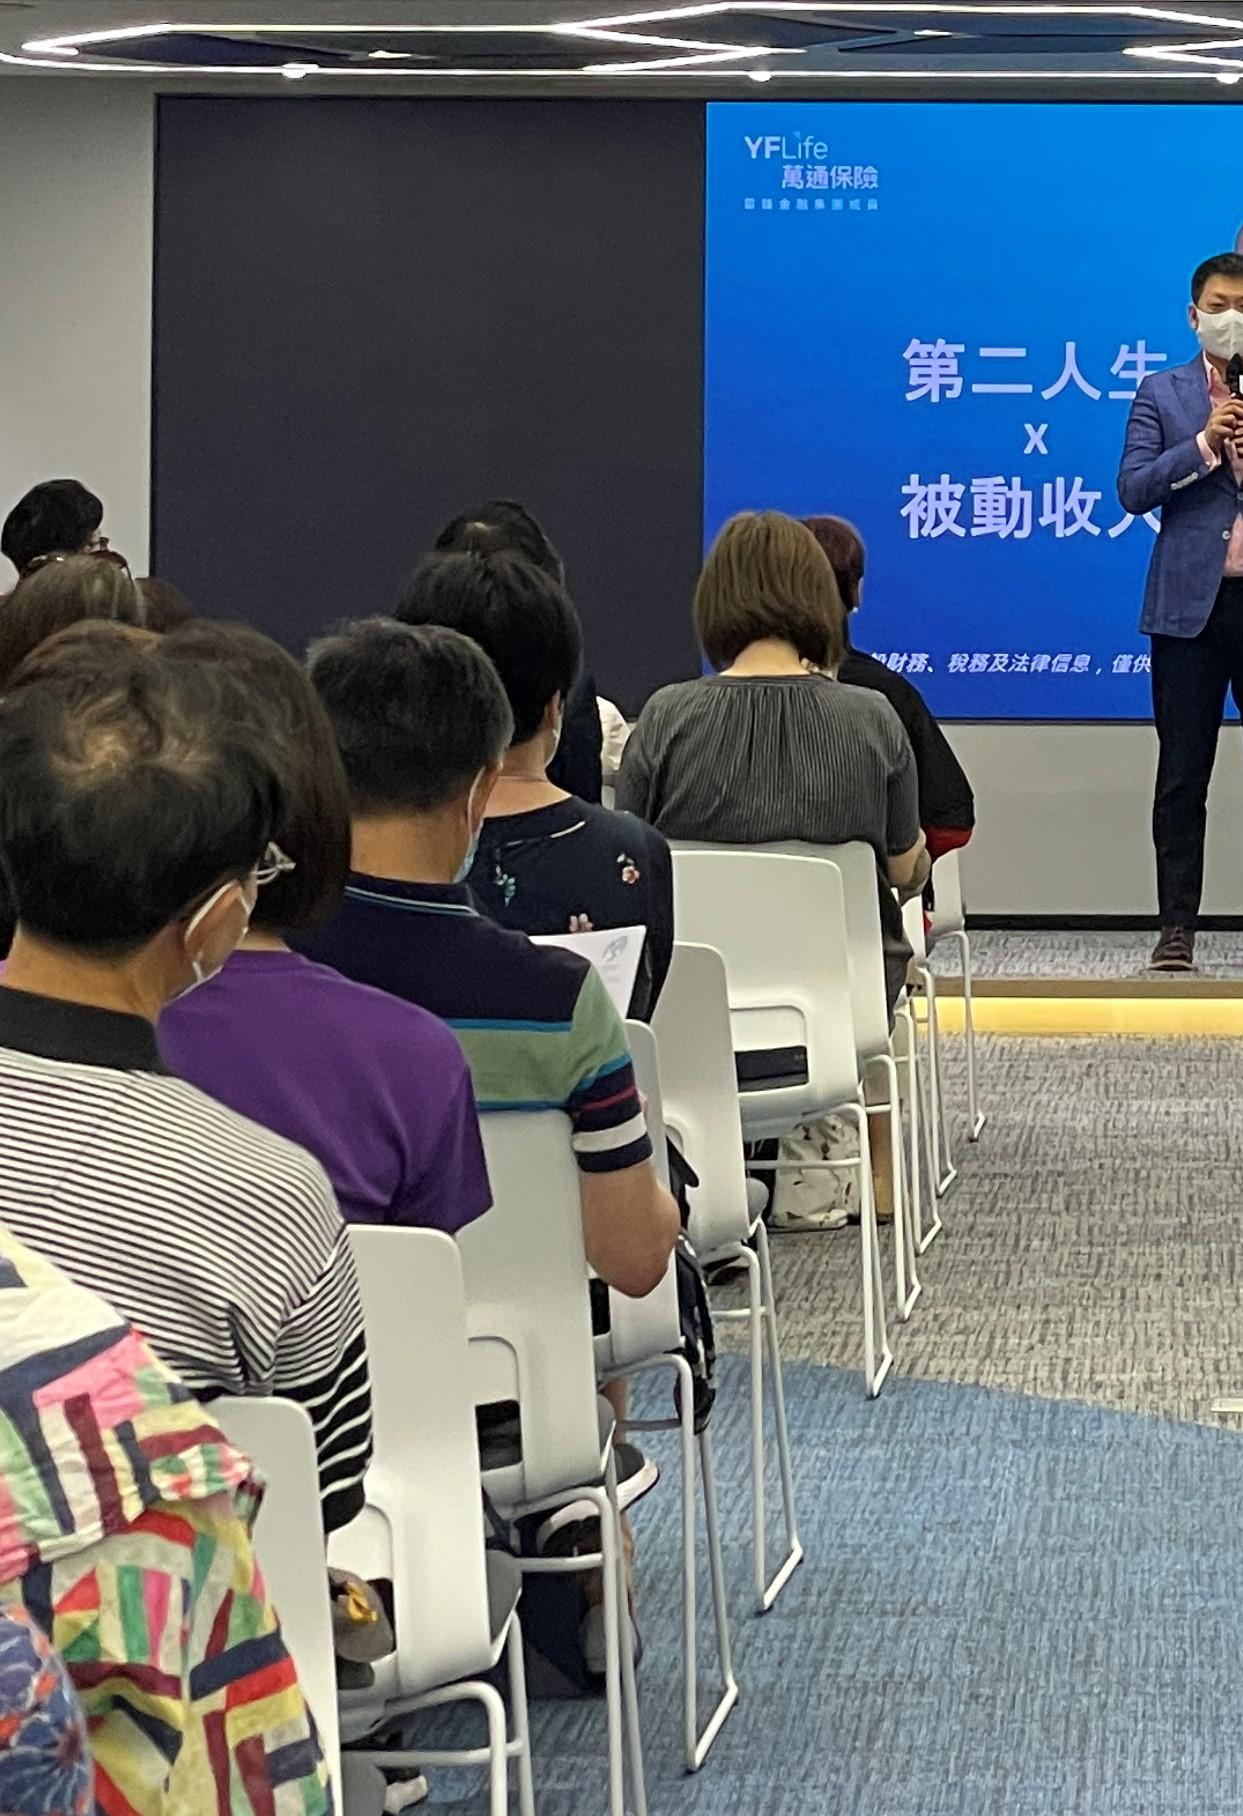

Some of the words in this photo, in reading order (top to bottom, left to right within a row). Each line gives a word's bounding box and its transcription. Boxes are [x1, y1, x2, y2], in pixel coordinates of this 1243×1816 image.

[744, 132, 828, 160] YFLife
[782, 164, 879, 190] 萬通保險
[902, 338, 1167, 402] 第二人生
